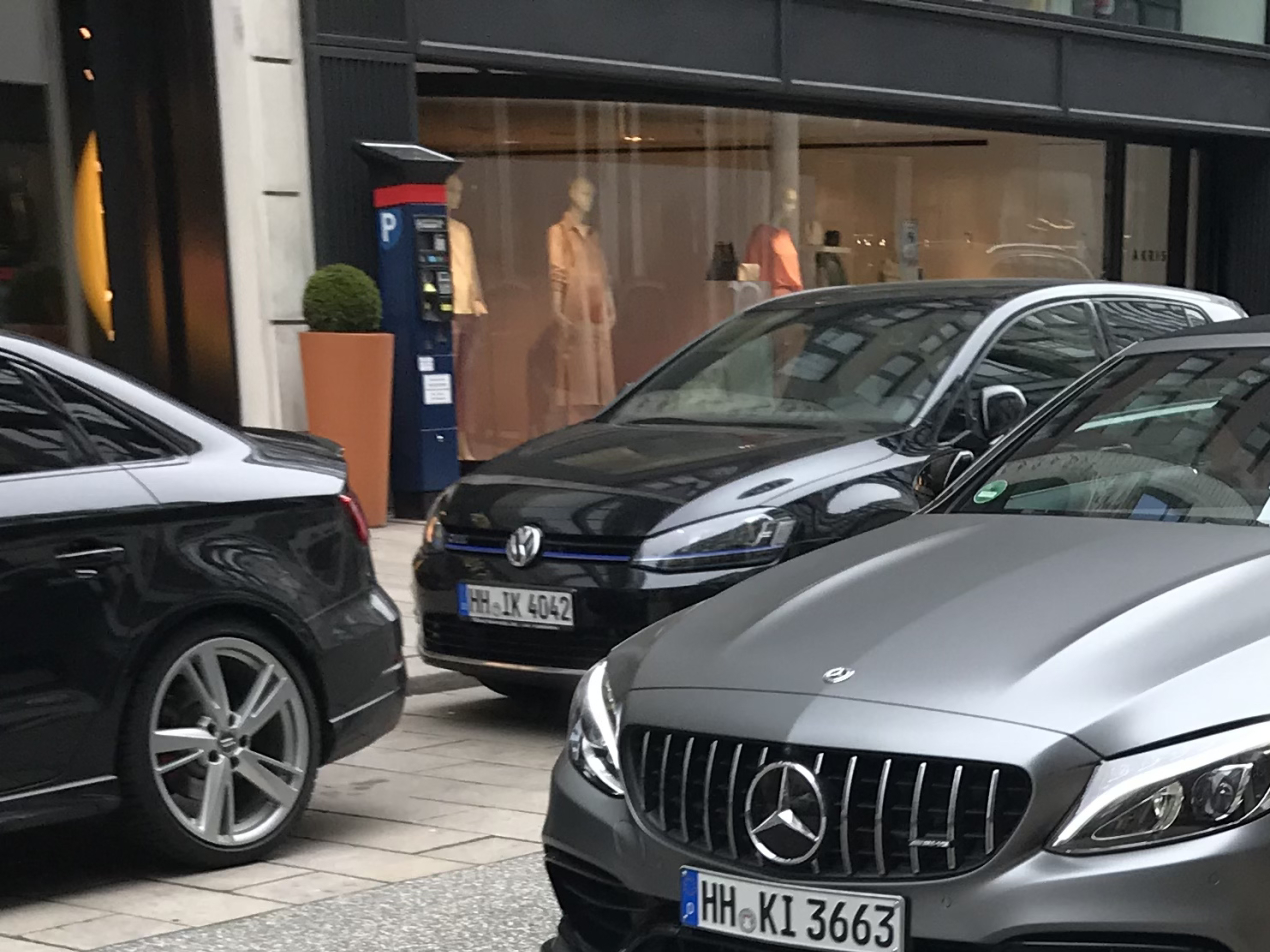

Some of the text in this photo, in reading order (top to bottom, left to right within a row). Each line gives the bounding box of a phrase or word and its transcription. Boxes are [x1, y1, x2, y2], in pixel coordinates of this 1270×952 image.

[379, 211, 397, 243] P
[469, 588, 491, 615] HH
[528, 593, 572, 621] 4042
[702, 880, 895, 948] HH KI 3663
